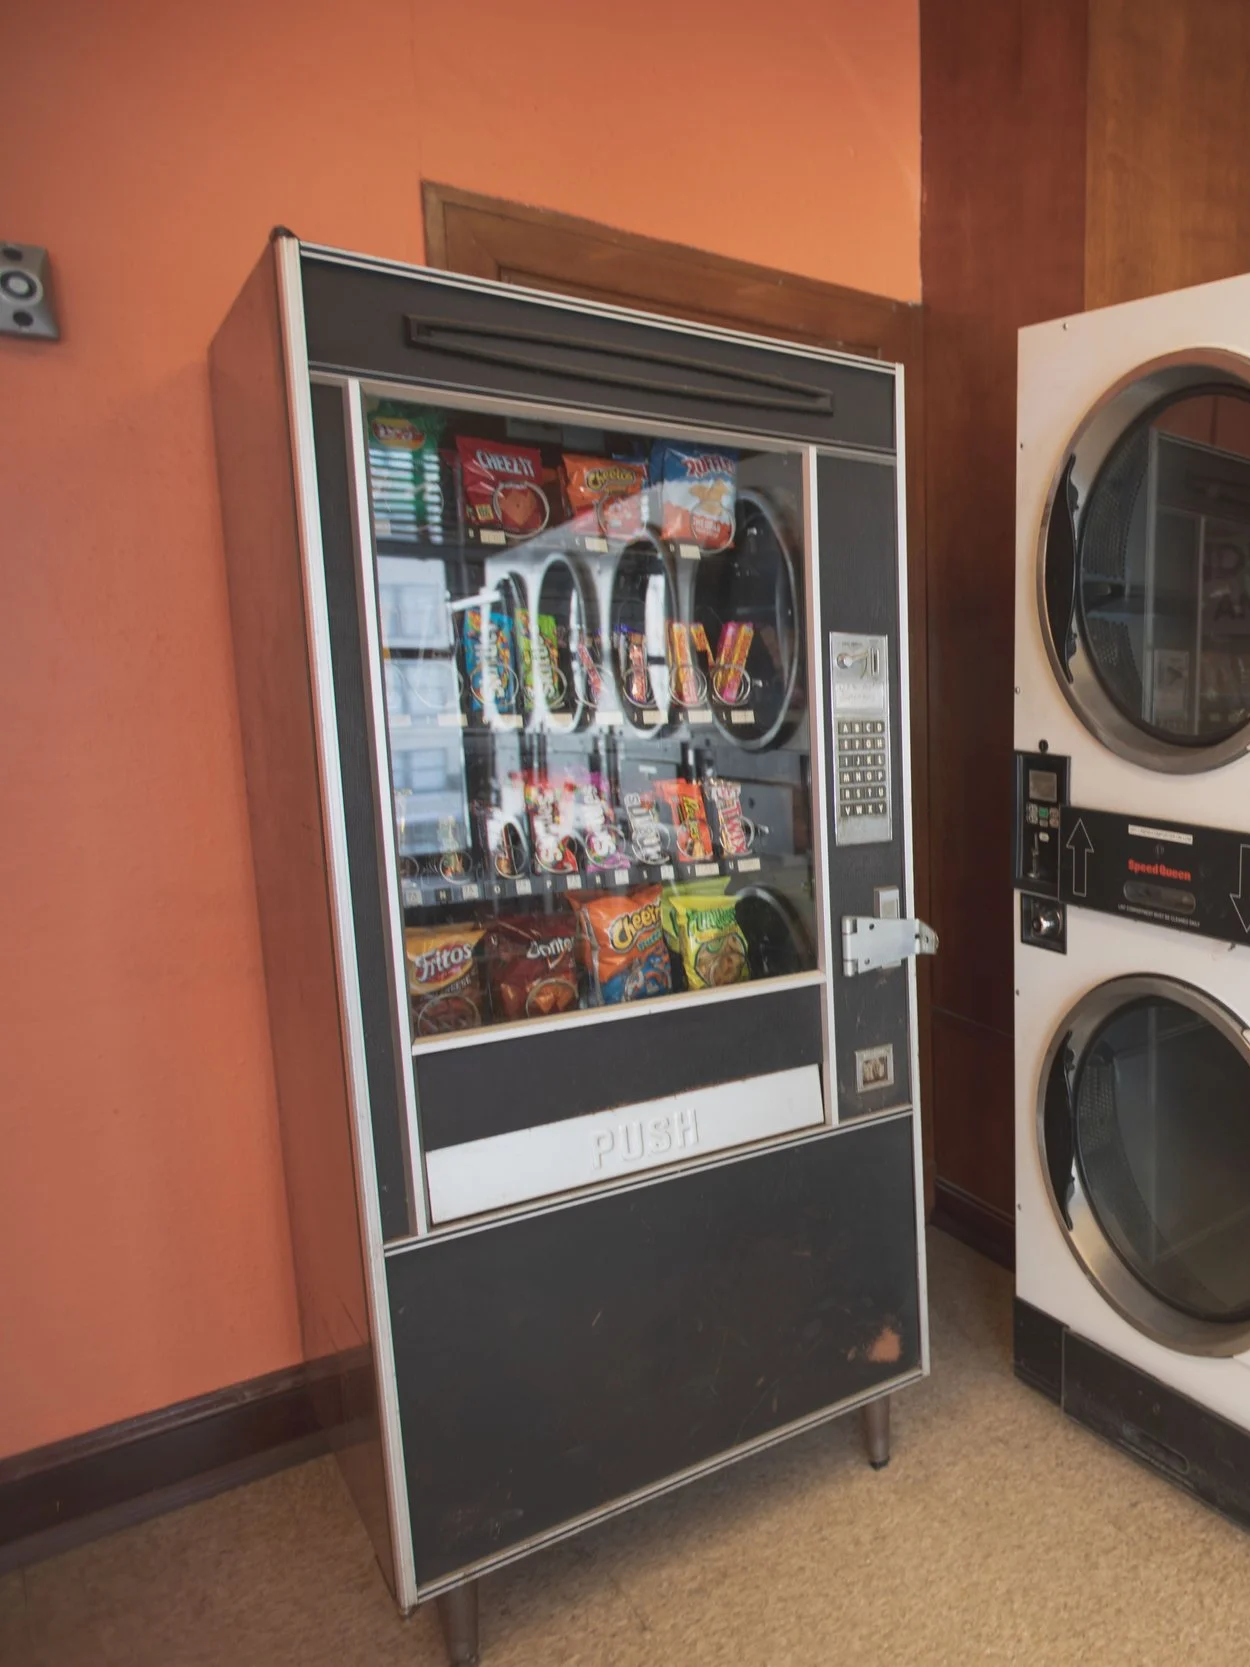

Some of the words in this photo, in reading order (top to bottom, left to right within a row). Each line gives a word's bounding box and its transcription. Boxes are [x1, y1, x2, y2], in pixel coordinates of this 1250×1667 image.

[1128, 858, 1158, 875] Speed
[1159, 864, 1192, 881] Queen
[611, 901, 661, 951] Cheet
[414, 943, 473, 984] Fritos
[591, 1108, 700, 1170] PUSH
